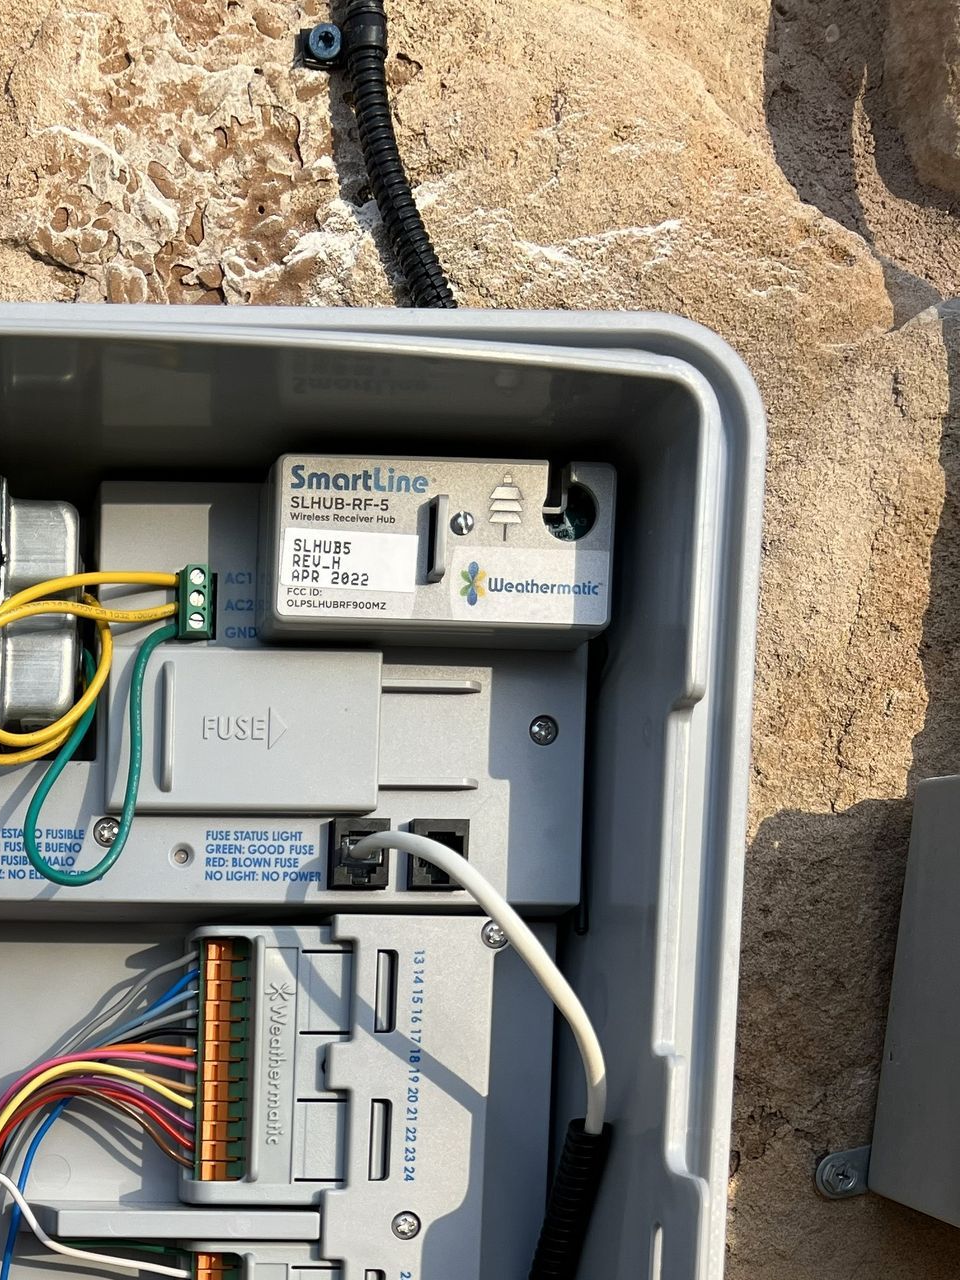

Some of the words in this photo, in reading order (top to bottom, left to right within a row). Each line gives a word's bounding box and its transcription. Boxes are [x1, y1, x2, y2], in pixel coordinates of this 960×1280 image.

[290, 464, 429, 494] SmartLine
[290, 496, 389, 511] SLHUB-RF-5
[290, 512, 330, 522] Wireless
[332, 513, 374, 524] Receiver
[376, 515, 396, 524] Hub
[293, 538, 352, 555] SLHUB5
[292, 554, 341, 570] REV_H
[224, 571, 253, 585] AC1
[291, 569, 320, 583] APR
[331, 571, 369, 586] 2022
[286, 587, 307, 596] FCC
[309, 588, 323, 597] ID:
[488, 577, 599, 596] Weathermatic
[224, 599, 254, 612] AC2
[286, 599, 387, 610] OLPSLHUBRF900MZ
[224, 626, 257, 639] GND
[202, 715, 265, 741] FUSE
[1, 828, 43, 840] ESTAO
[45, 829, 85, 840] FUSIBLE
[205, 830, 231, 841] FUSE
[233, 831, 269, 842] STATUS
[272, 831, 303, 842] LIGHT
[3, 842, 42, 853] FUSIE
[44, 842, 82, 853] BUENO
[205, 843, 245, 855] GREEN:
[247, 844, 285, 855] GOOD
[289, 844, 314, 856] FUSE
[0, 855, 33, 866] FUSIB
[44, 856, 75, 867] MALO
[205, 857, 229, 868] RED:
[231, 857, 271, 868] BLOWN
[274, 857, 299, 868] FUSE
[8, 869, 26, 880] NO
[205, 870, 223, 881] NO
[226, 870, 259, 882] LIGHT:
[261, 871, 280, 882] NO
[282, 871, 321, 882] POWER
[413, 950, 426, 965] 13
[413, 969, 424, 984] 14
[411, 989, 424, 1004] 15
[410, 1009, 423, 1024] 16
[409, 1029, 422, 1043] 17
[409, 1049, 421, 1064] 18
[265, 1004, 287, 1146] Weathermatic
[408, 1068, 420, 1083] 19
[407, 1087, 419, 1103] 20
[406, 1107, 418, 1121] 21
[405, 1127, 417, 1142] 22
[404, 1146, 417, 1163] 23
[403, 1167, 416, 1182] 24
